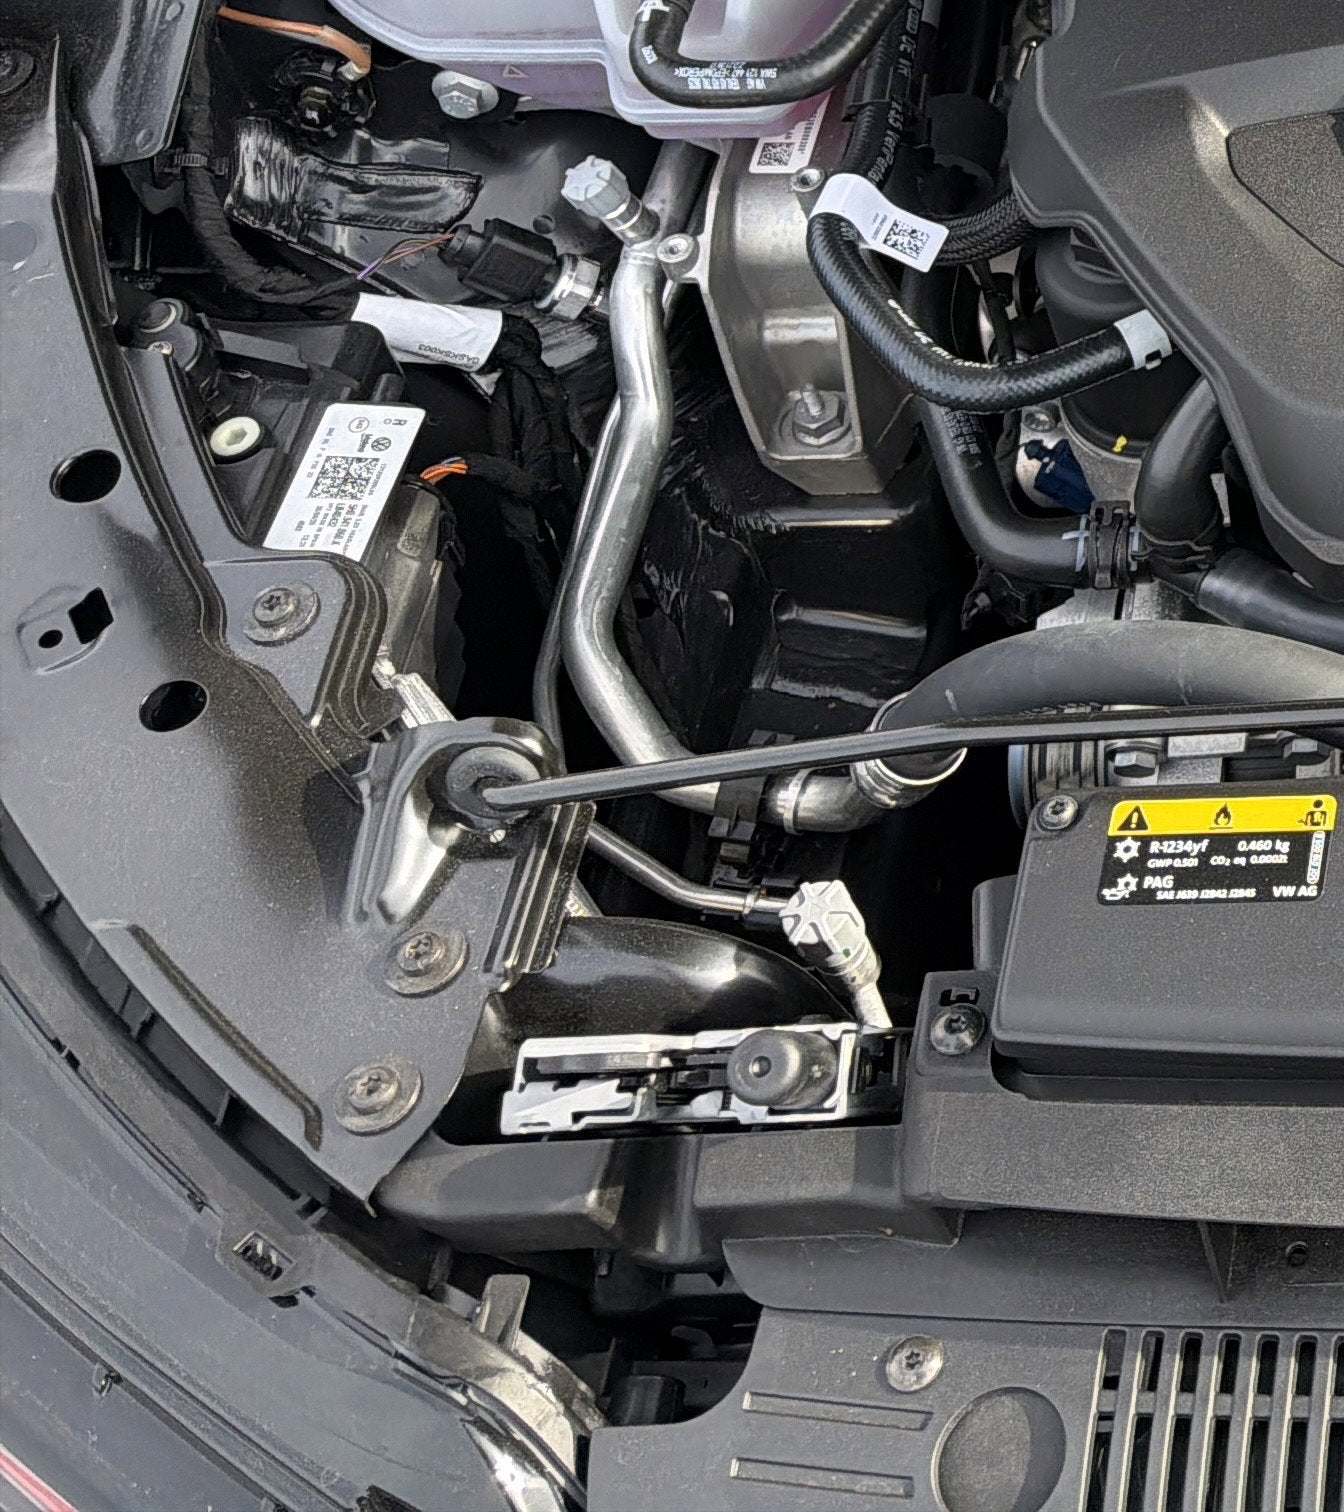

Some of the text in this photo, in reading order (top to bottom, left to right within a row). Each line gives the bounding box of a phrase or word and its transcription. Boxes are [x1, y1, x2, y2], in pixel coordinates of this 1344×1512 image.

[1150, 839, 1290, 856] R-1234yf 0.460 kg
[1147, 858, 1172, 868] GWP
[1173, 858, 1198, 868] 0.501
[1233, 856, 1246, 866] eq
[1143, 875, 1174, 888] PAG
[1156, 886, 1318, 900] SAE VW AG
